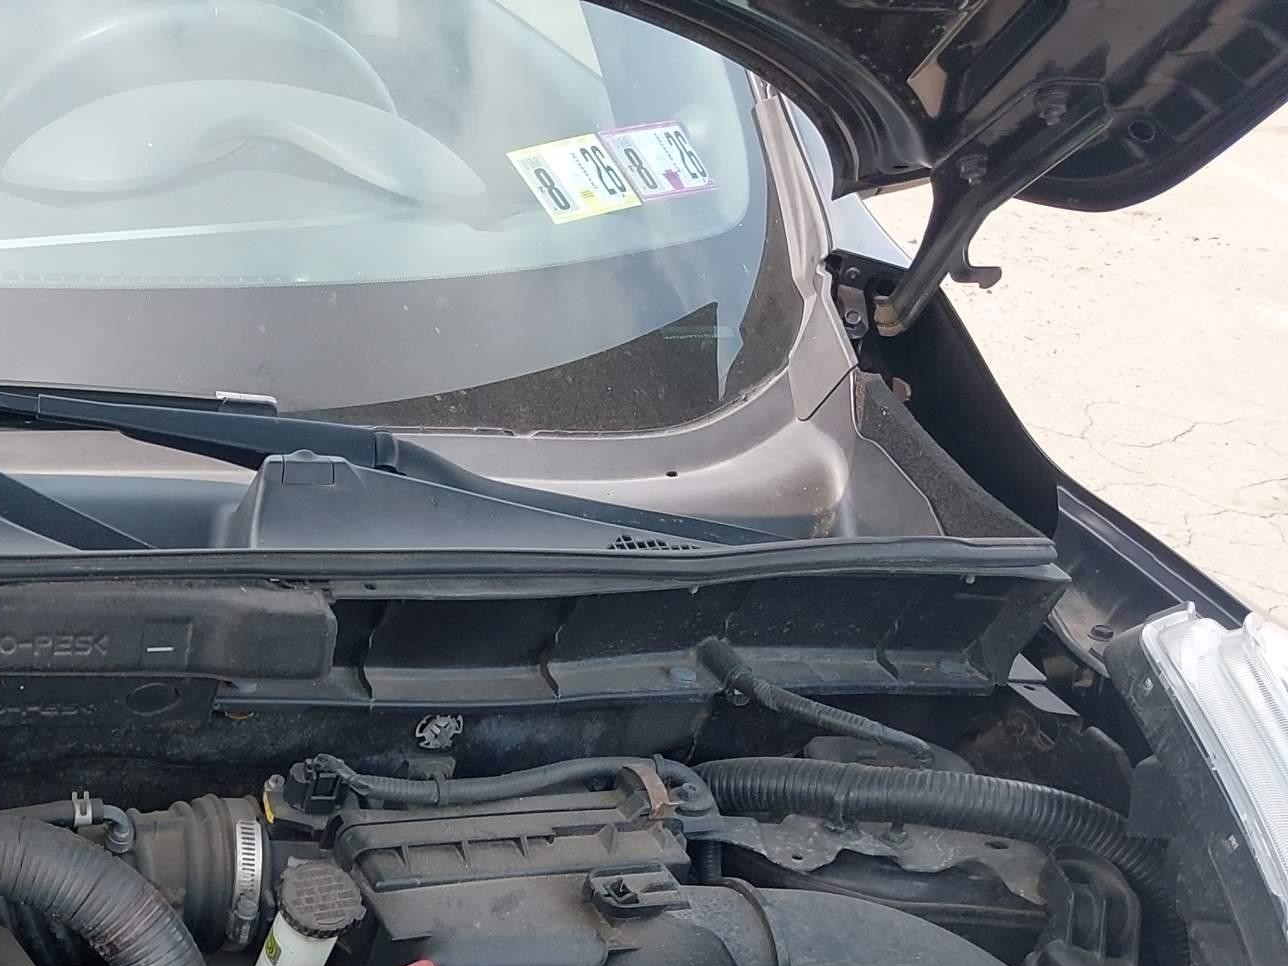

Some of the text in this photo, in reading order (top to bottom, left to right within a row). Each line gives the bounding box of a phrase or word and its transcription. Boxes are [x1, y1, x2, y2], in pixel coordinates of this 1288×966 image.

[534, 168, 570, 210] 8
[580, 145, 627, 195] 26
[624, 148, 658, 189] 8
[664, 130, 707, 178] 26
